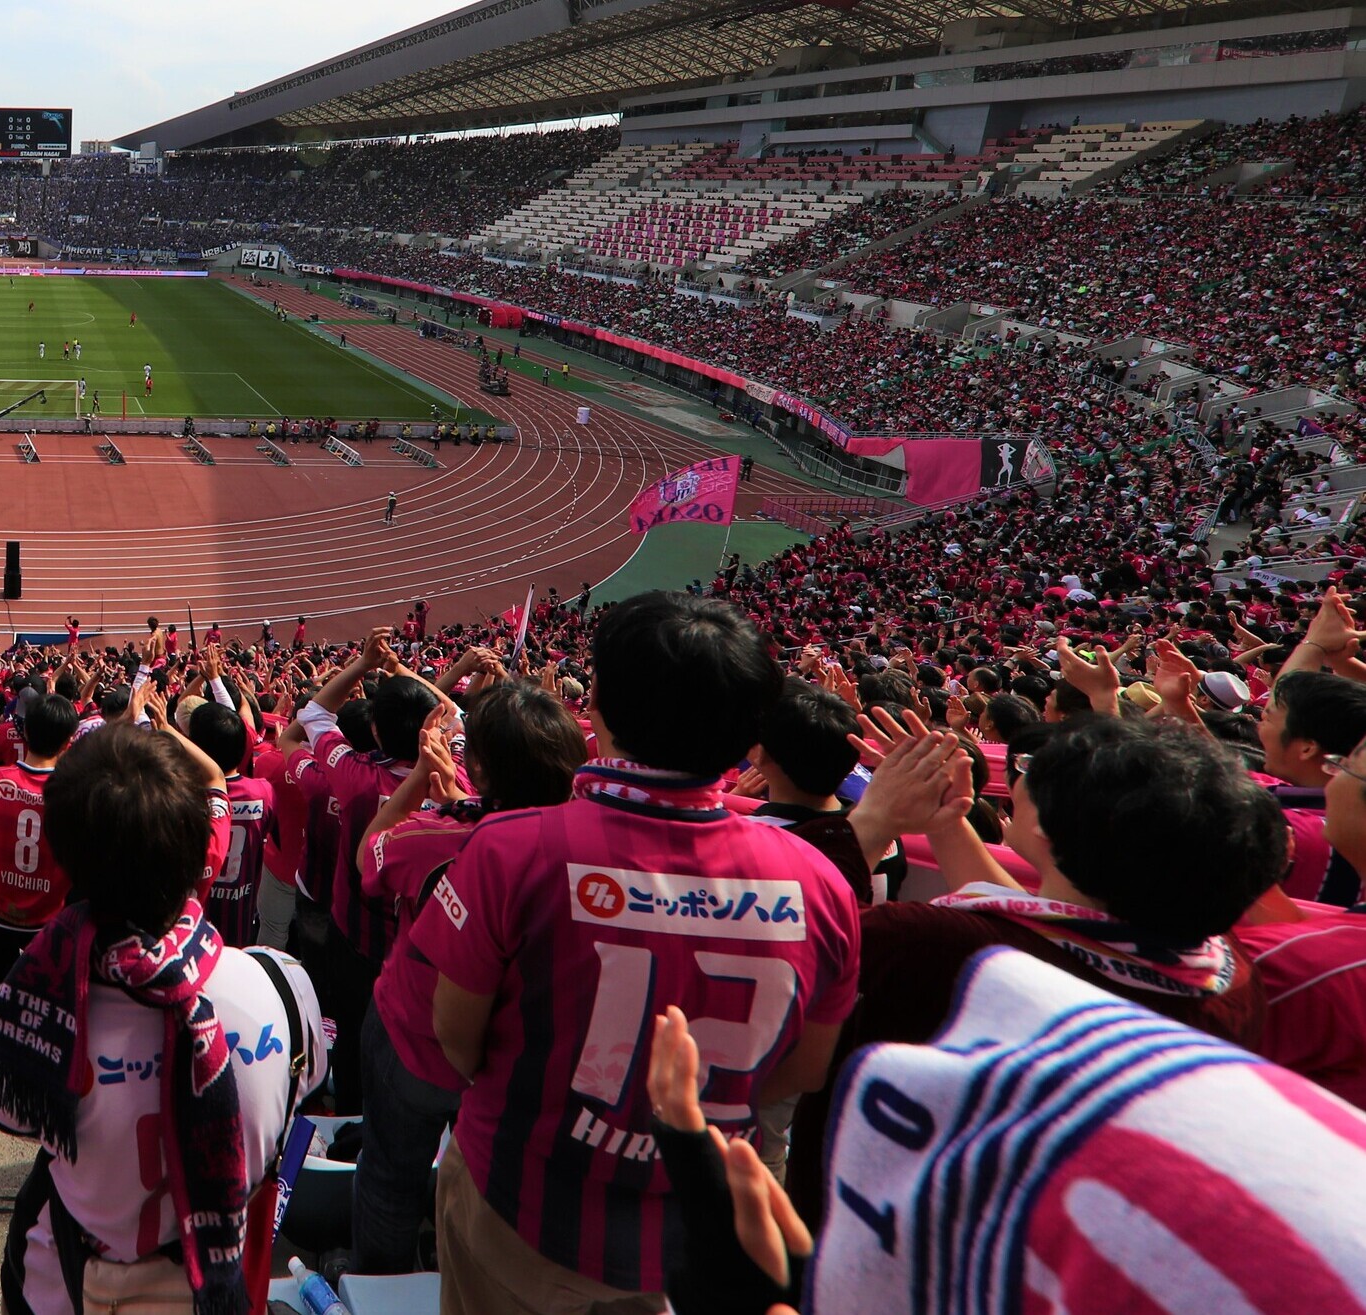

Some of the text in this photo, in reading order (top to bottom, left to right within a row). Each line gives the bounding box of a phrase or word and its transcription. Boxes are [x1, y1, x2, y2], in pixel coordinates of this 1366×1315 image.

[14, 808, 42, 874] 8
[0, 870, 51, 893] YOICHIRO
[627, 887, 799, 925] ニッポンハム
[17, 989, 51, 1017] THE
[55, 1006, 78, 1035] TO
[20, 1009, 43, 1030] OF
[183, 1211, 222, 1235] FOR
